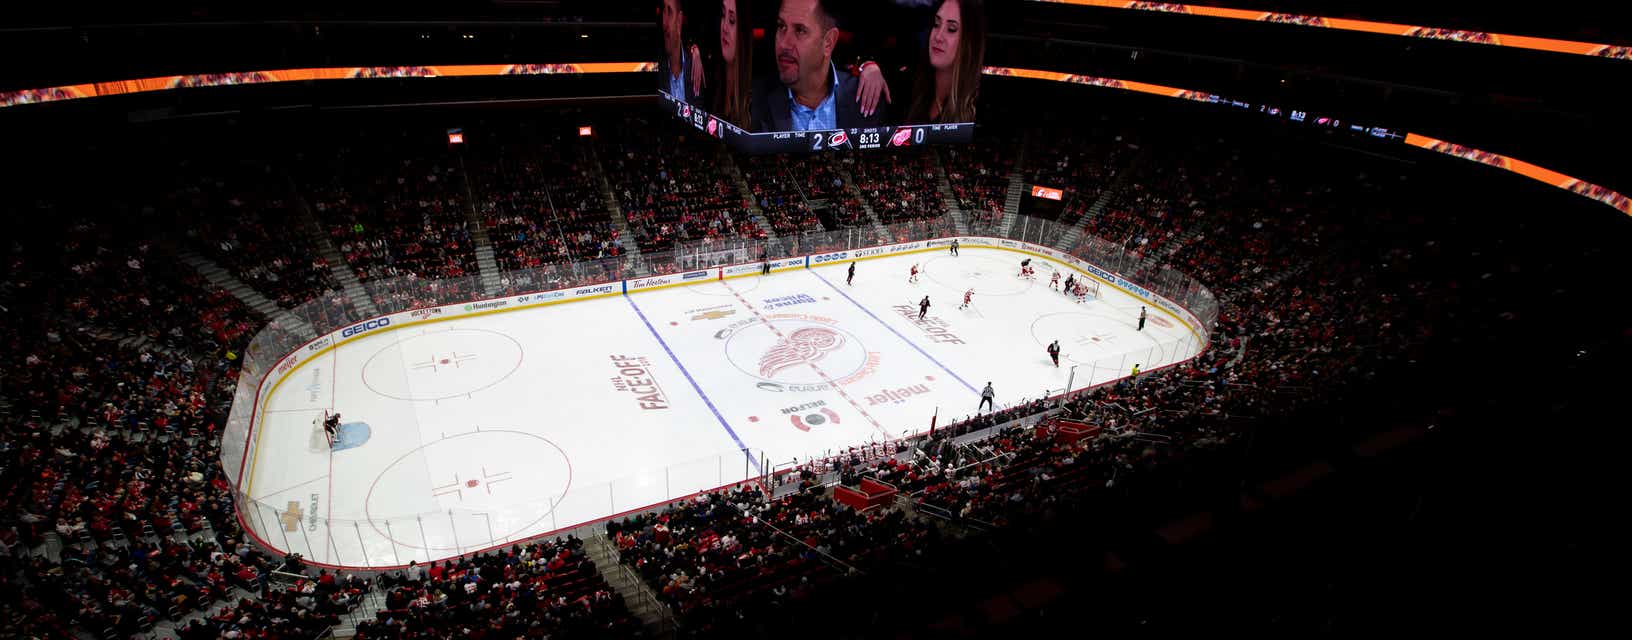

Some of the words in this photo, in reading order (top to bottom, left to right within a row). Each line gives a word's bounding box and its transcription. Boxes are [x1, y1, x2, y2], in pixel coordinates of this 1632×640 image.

[812, 133, 823, 150] 2
[859, 133, 880, 144] 8:13
[915, 127, 925, 144] 0
[1087, 264, 1116, 283] GEICO
[575, 285, 613, 296] FALKEN
[633, 280, 646, 289] Tim
[472, 300, 507, 311] Huntington
[341, 317, 390, 338] GEICO
[863, 384, 931, 406] meijer
[780, 399, 827, 415] BELFOR
